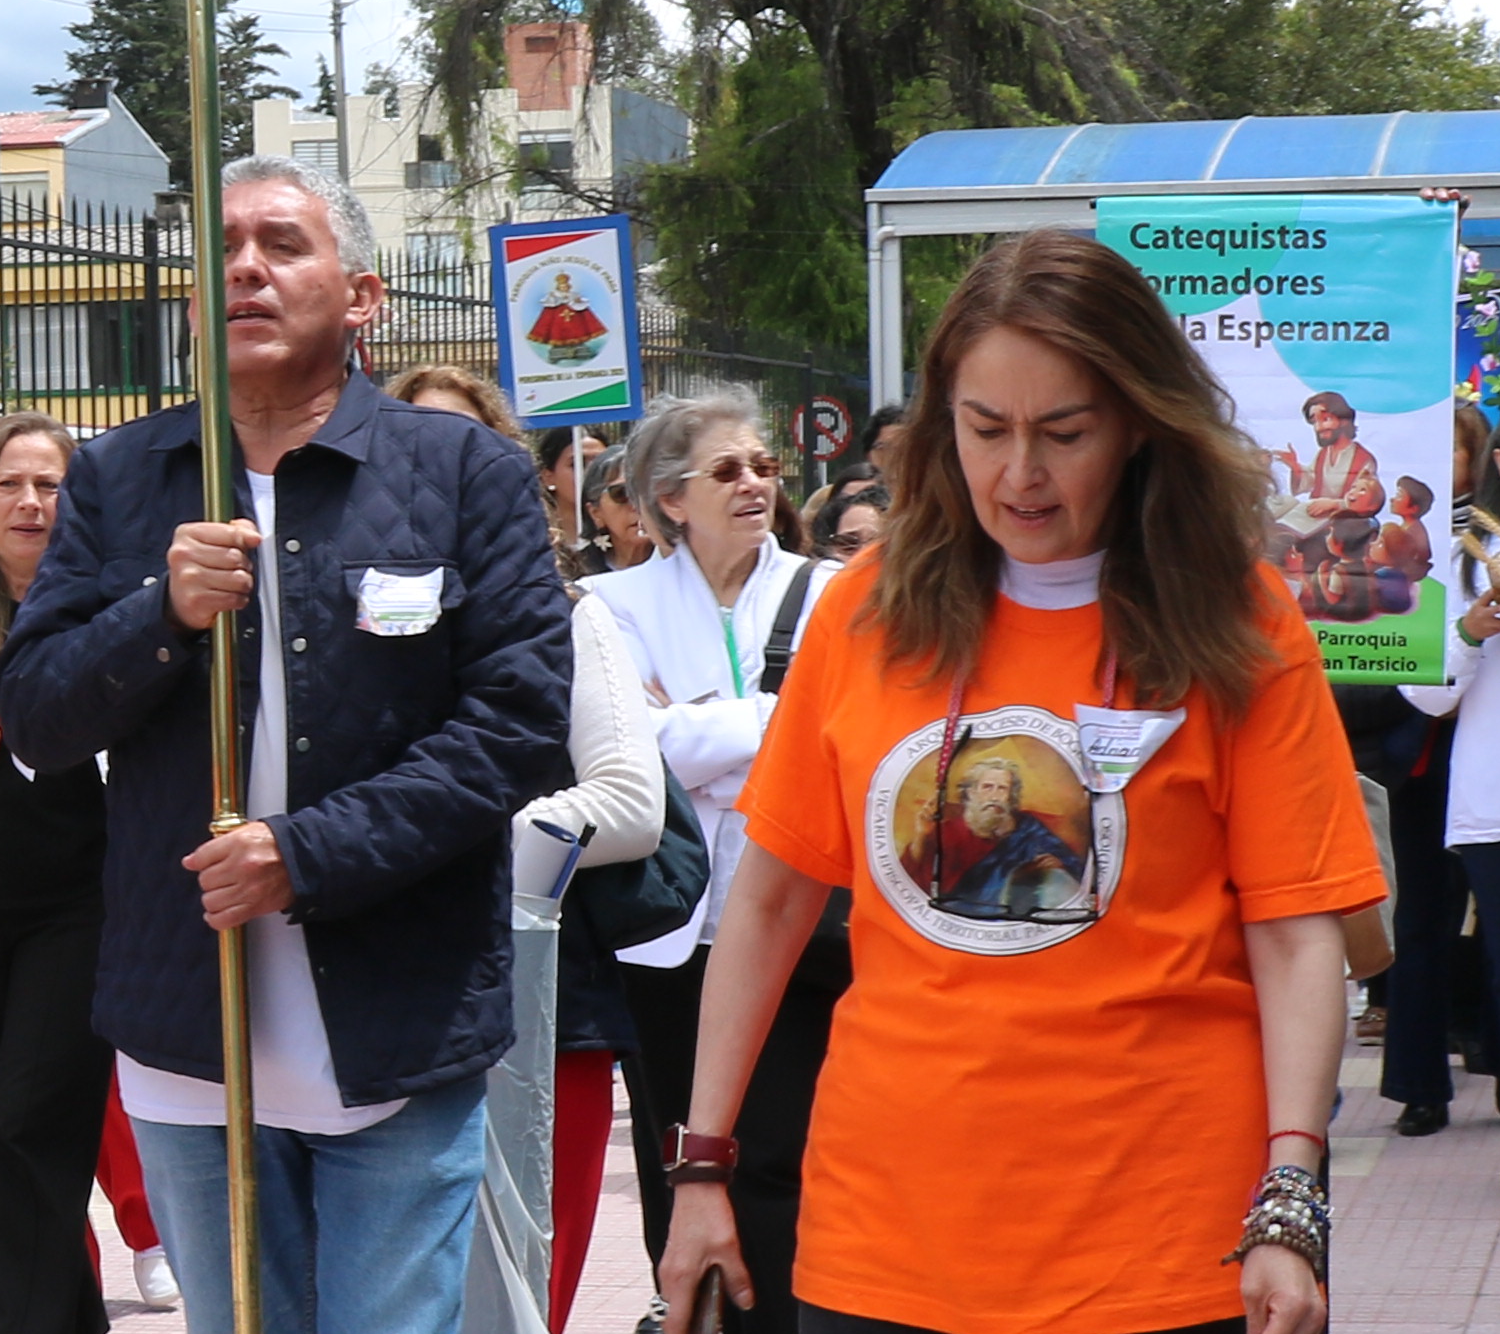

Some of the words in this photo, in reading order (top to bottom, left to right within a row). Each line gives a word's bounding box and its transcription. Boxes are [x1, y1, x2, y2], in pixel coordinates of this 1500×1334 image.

[1129, 222, 1327, 256] Catequistas
[1146, 267, 1326, 296] ormadores
[1217, 314, 1391, 349] Esperanza
[1317, 630, 1408, 650] Parroquia
[1322, 658, 1344, 670] an
[1347, 655, 1418, 672] Tarsicio
[1028, 717, 1054, 734] DE
[931, 919, 1022, 942] TERRITORIAL
